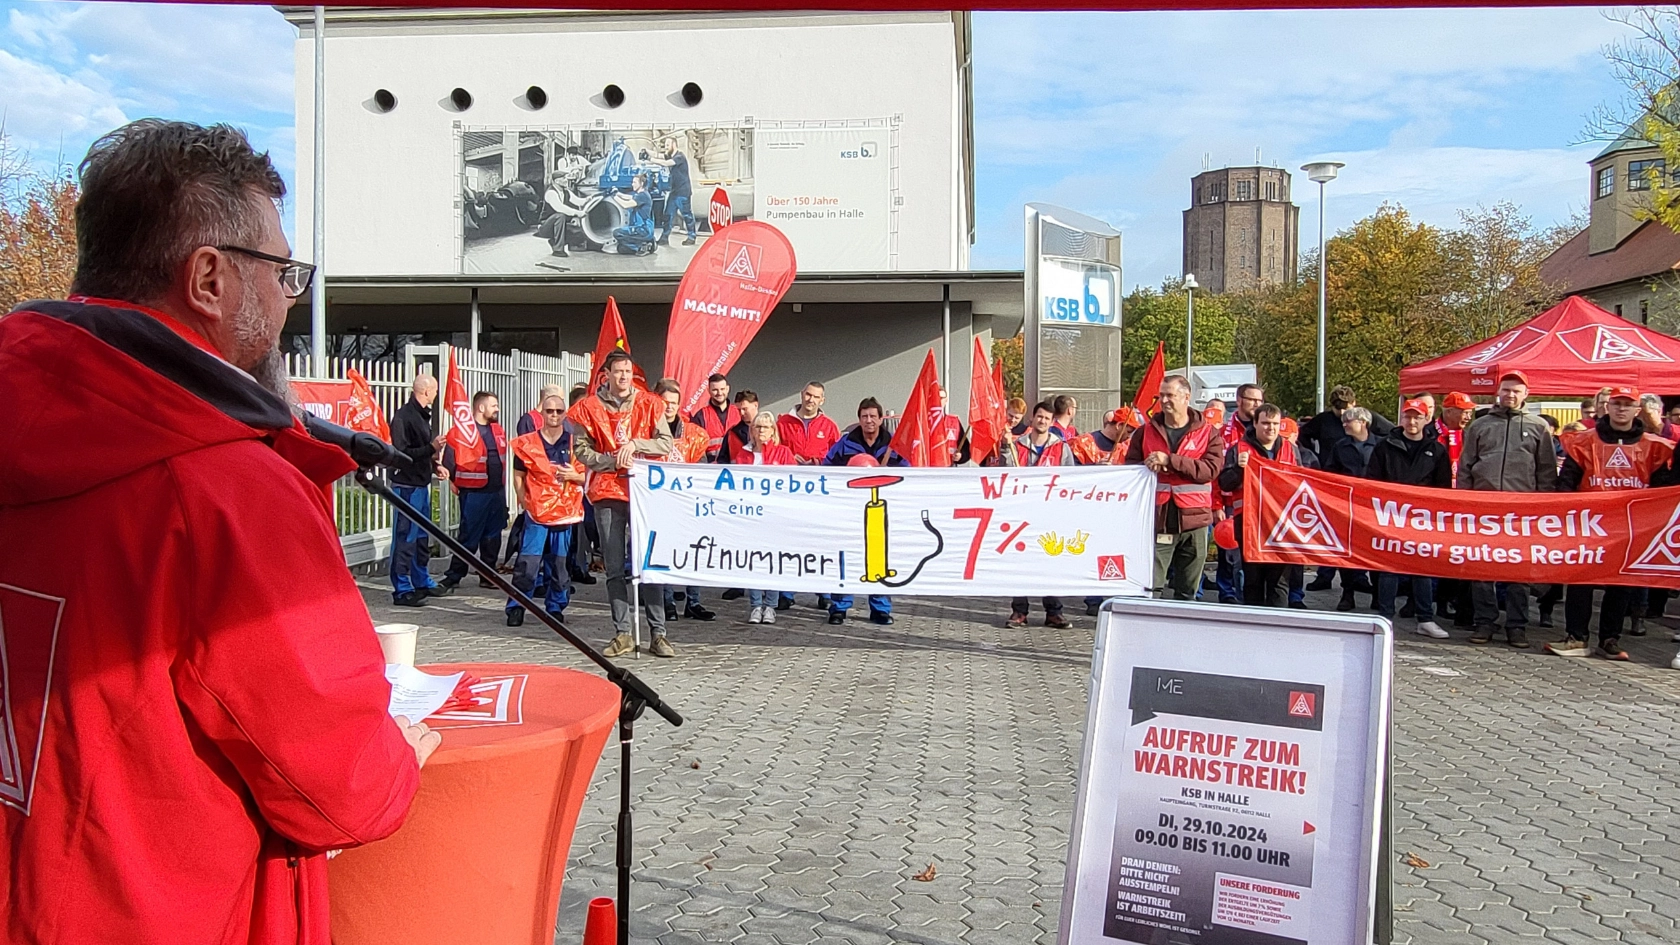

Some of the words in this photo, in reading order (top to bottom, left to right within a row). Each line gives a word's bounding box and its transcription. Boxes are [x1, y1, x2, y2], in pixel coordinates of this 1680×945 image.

[766, 196, 790, 205] Über
[794, 197, 810, 205] 150
[813, 197, 839, 205] Jahre
[711, 201, 731, 227] STOP
[766, 210, 824, 220] Pumpenbau
[827, 210, 836, 218] in
[839, 209, 864, 218] Halle
[684, 299, 728, 316] MACH
[730, 307, 761, 322] MIT!
[1044, 296, 1080, 321] KSB
[714, 468, 830, 496] Angebot
[980, 473, 1029, 500] Wir
[1043, 474, 1129, 502] fordern
[695, 497, 716, 517] ist
[729, 499, 764, 516] eine
[1371, 497, 1608, 537] Warnstreik
[1371, 536, 1443, 558] unser
[1449, 543, 1522, 564] gutes
[1530, 543, 1606, 564] Recht
[1142, 726, 1238, 758] AUFRUF
[1243, 737, 1300, 766] ZUM
[1134, 750, 1307, 795] WARNSTREIK!
[1181, 787, 1202, 799] KSB
[1204, 790, 1215, 801] IN
[1217, 792, 1250, 806] HALLE
[1158, 813, 1178, 831] DI,
[1182, 817, 1268, 844] 29.10.2024
[1134, 828, 1178, 849] 09.00
[1182, 836, 1208, 853] BIS
[1211, 840, 1253, 861] 11.00
[1256, 847, 1291, 868] UHR
[1120, 866, 1144, 879] BITTE
[1144, 870, 1170, 883] NICHT
[1121, 856, 1145, 869] DRAN
[1145, 860, 1181, 875] DENKEN:
[1119, 877, 1180, 896] AUSSTEMPELN!
[1220, 878, 1250, 891] UNSERE
[1252, 884, 1300, 900] FORDERUNG
[1117, 890, 1172, 909] WARNSTREIK
[1116, 900, 1130, 911] IST
[1131, 903, 1186, 923] ARBEITSZEIT!
